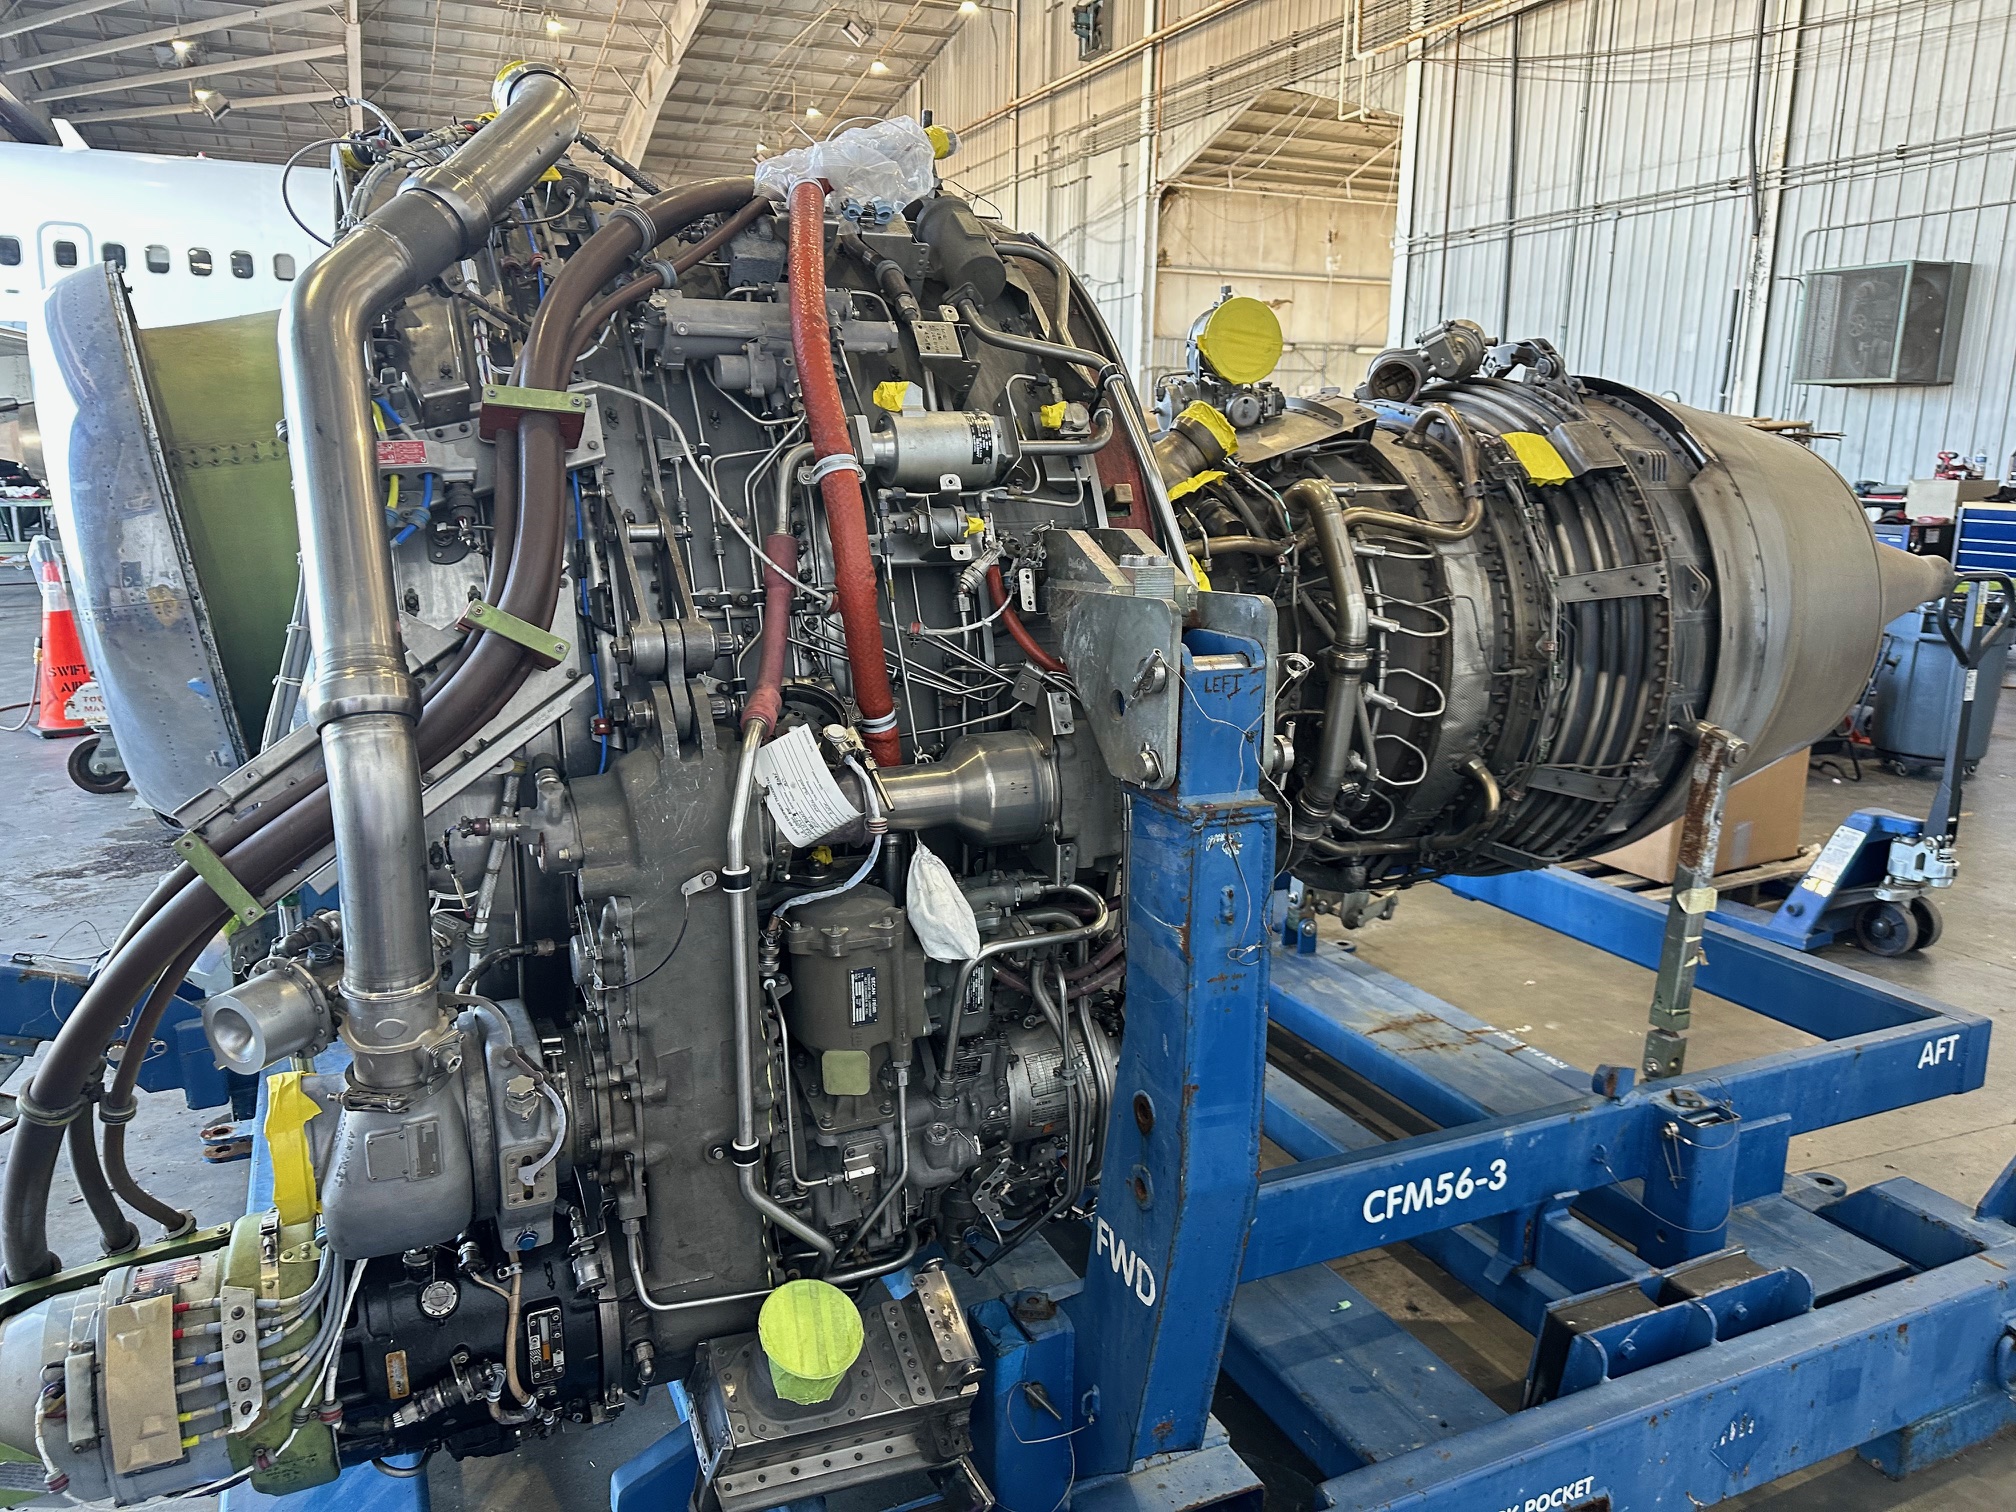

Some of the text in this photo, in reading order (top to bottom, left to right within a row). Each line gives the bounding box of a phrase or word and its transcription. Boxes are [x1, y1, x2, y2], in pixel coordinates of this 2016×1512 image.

[48, 664, 87, 677] SWIFT
[1204, 674, 1244, 694] LEFT
[768, 783, 779, 802] TRACKING
[776, 801, 790, 821] EQUIPMENT
[1917, 1033, 1959, 1069] AFT
[1362, 1157, 1507, 1223] CFM56-3
[1096, 1215, 1155, 1306] FWD
[1524, 1476, 1595, 1512] POCKET
